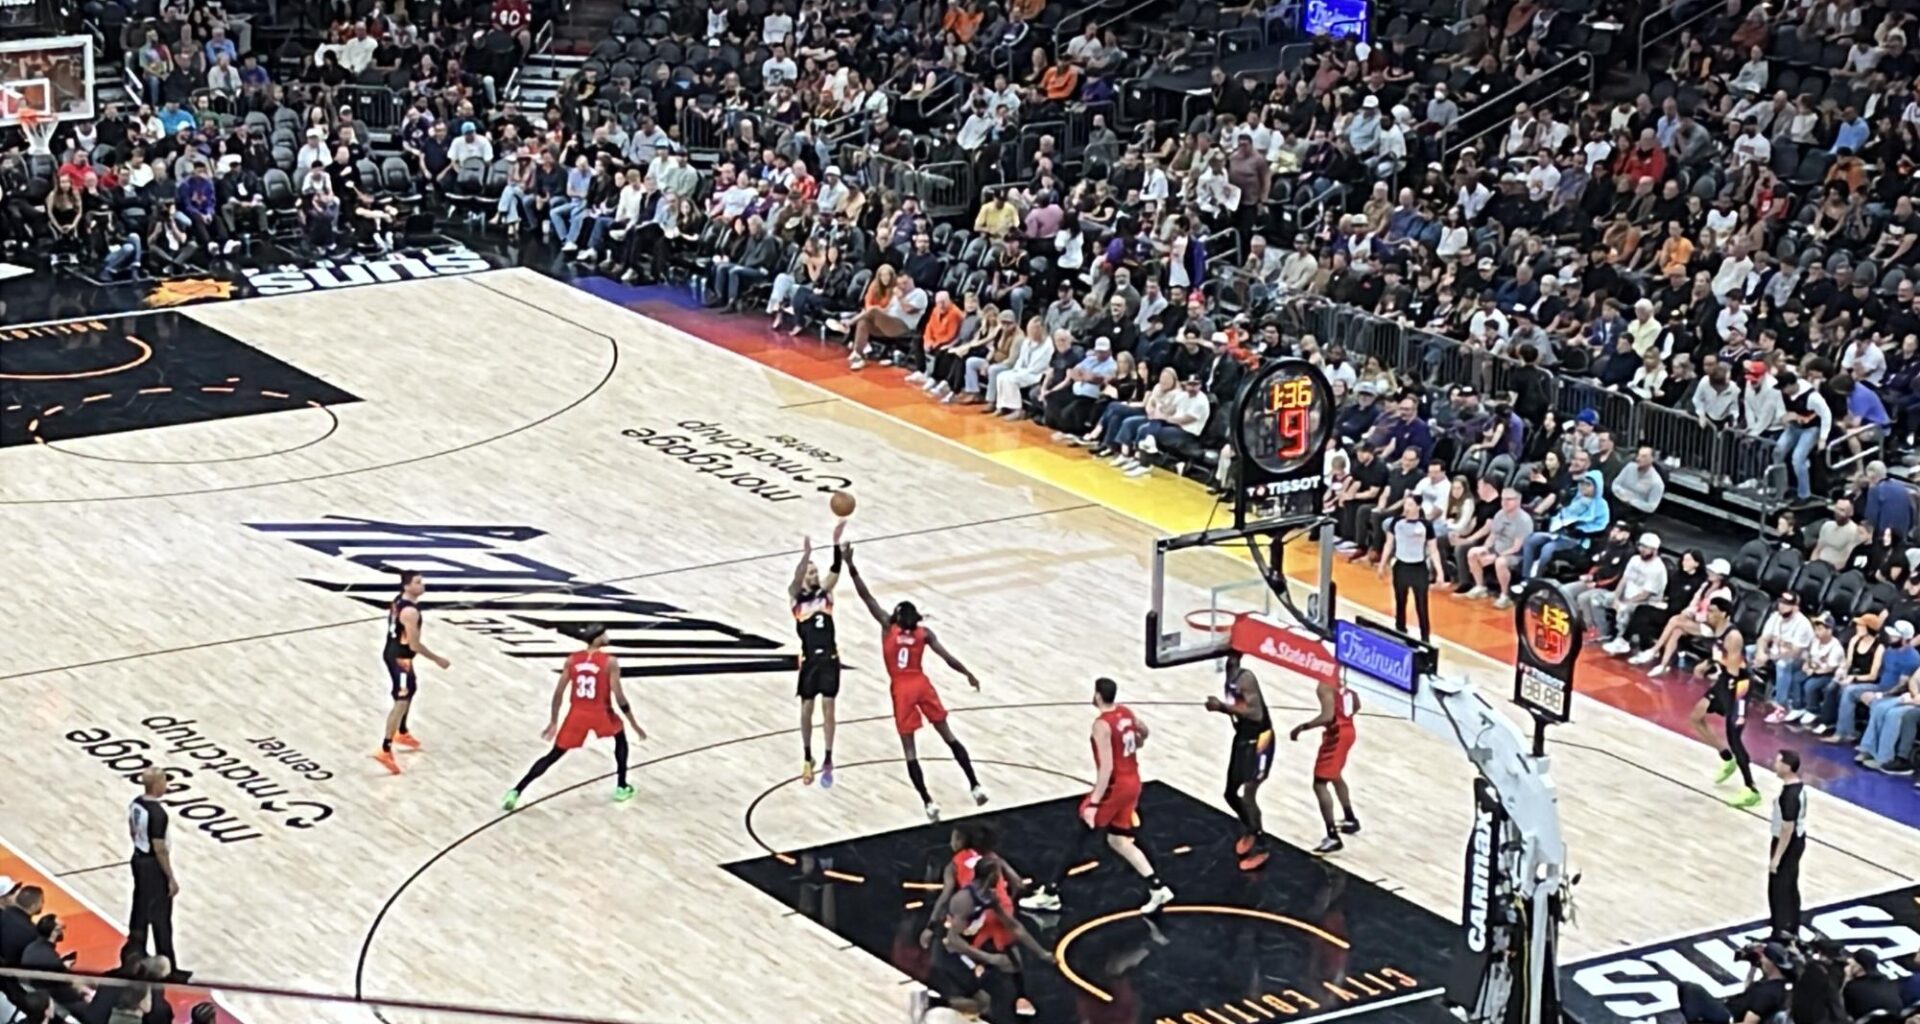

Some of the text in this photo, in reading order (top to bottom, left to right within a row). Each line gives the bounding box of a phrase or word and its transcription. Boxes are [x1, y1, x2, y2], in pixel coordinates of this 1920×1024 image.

[1273, 376, 1312, 410] 1:36
[677, 420, 812, 474] matchup
[765, 434, 843, 463] center
[1281, 408, 1305, 458] 9
[621, 428, 802, 501] mortgage
[1267, 476, 1321, 496] TISSOT
[815, 614, 824, 628] 2
[897, 646, 909, 669] 9
[1340, 631, 1411, 683] Trainual
[576, 674, 596, 699] 33
[141, 716, 289, 798] matchup
[245, 736, 334, 781] center
[1322, 967, 1417, 1001] CITY
